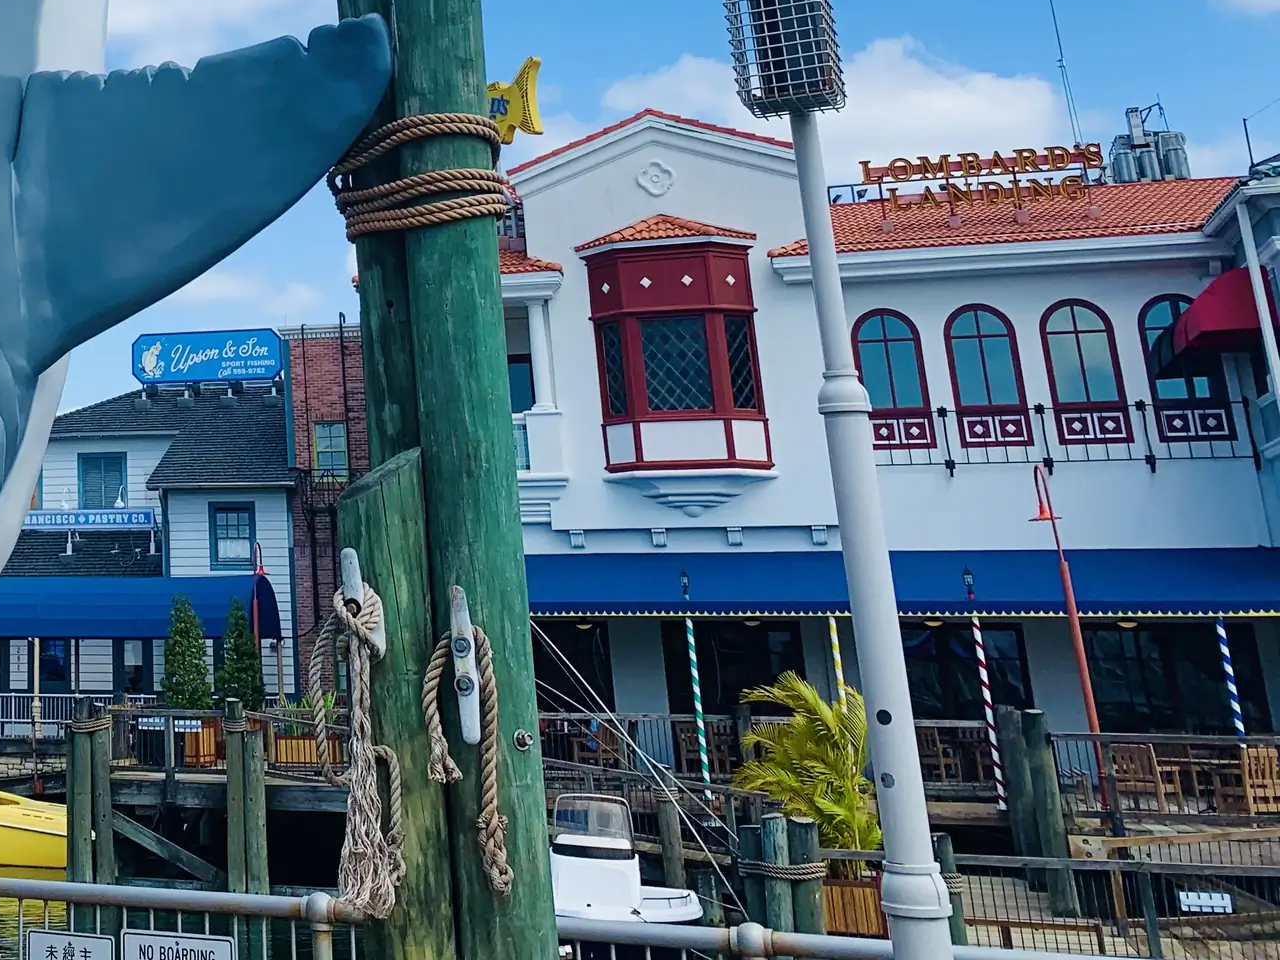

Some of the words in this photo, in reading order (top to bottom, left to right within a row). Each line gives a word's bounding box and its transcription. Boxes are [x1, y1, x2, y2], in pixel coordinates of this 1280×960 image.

[858, 143, 1104, 185] LOMBARD'S
[886, 175, 1087, 212] LANDING
[170, 344, 220, 374] Upson
[222, 339, 237, 358] &
[238, 337, 269, 358] Son
[247, 359, 276, 367] FISHING
[88, 513, 129, 524] PASTRY
[131, 513, 148, 523] CO.
[138, 943, 154, 960] NO
[159, 945, 216, 960] BOARDING
